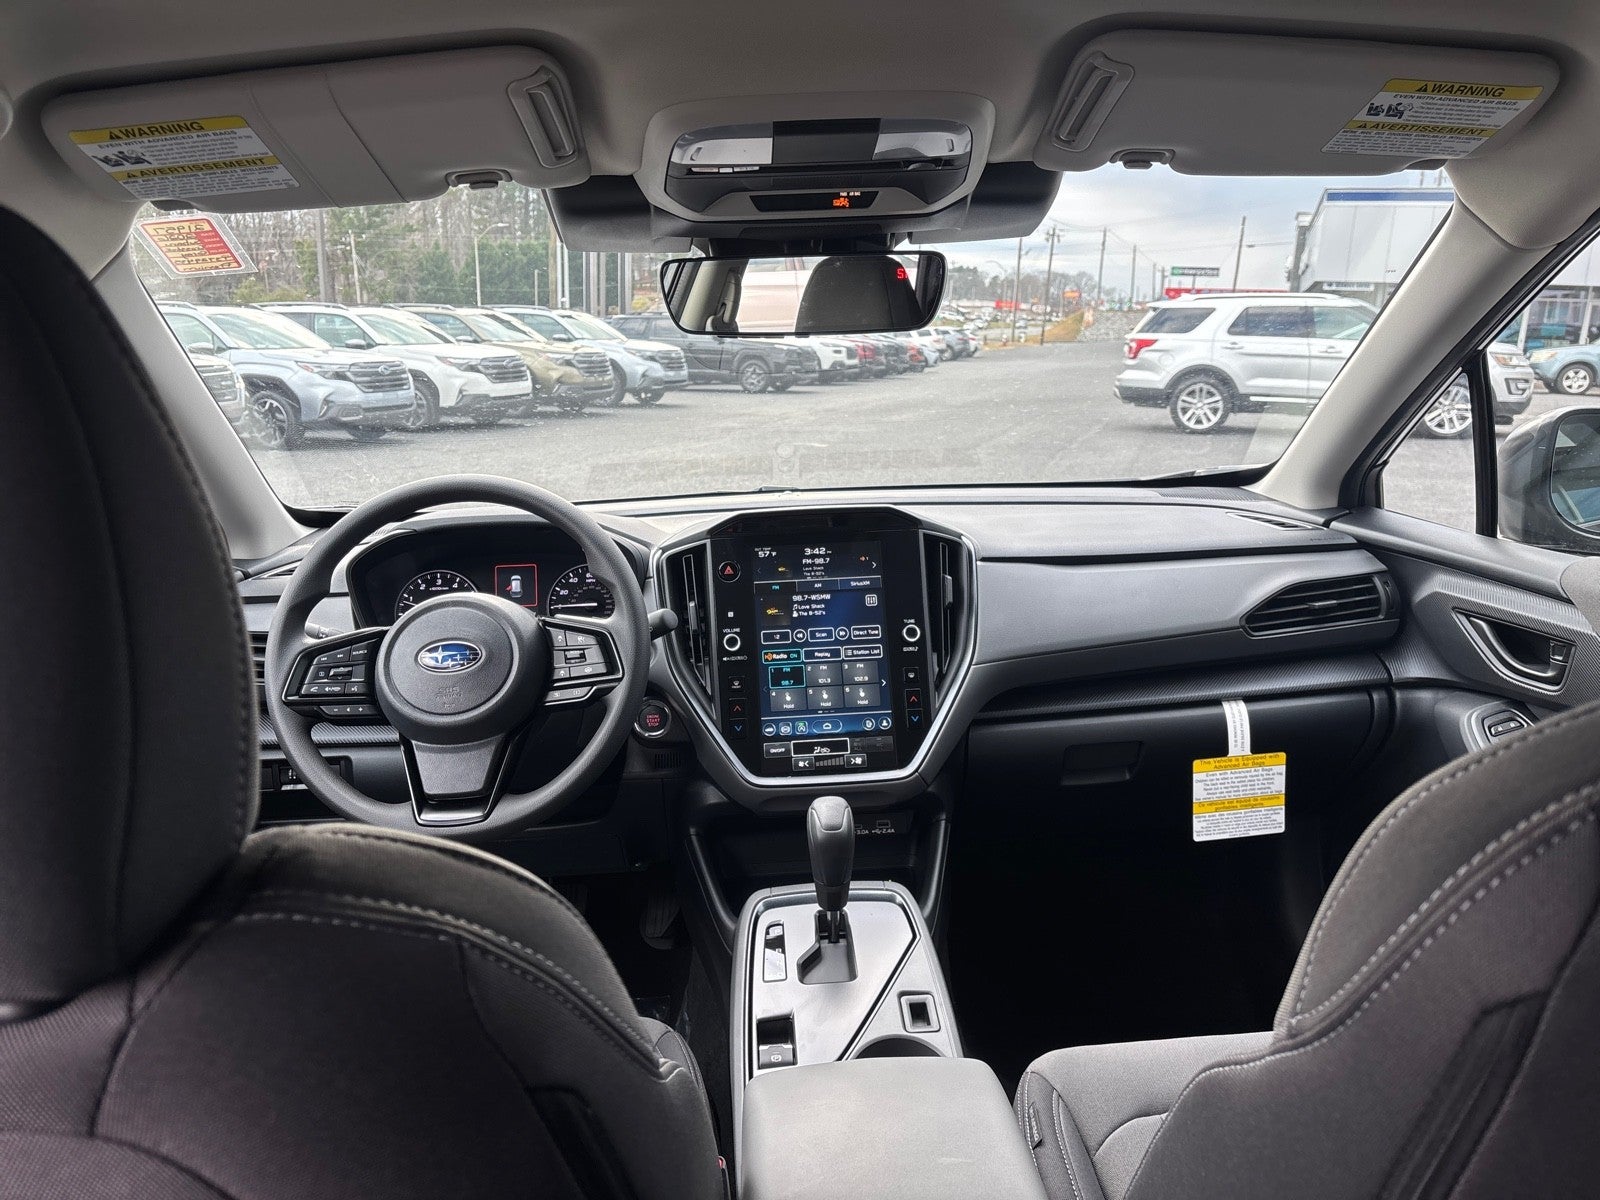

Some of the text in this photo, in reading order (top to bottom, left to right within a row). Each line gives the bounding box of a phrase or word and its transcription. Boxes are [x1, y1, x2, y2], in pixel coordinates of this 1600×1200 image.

[1430, 83, 1506, 97] WARNING
[1436, 96, 1481, 104] ADVANCED
[122, 121, 205, 139] WARNING
[1371, 123, 1487, 136] AVERTISSEMENT
[147, 134, 193, 144] ADVANCED
[140, 158, 266, 178] AVERTISSEMENT
[804, 547, 826, 555] 3:42
[792, 594, 831, 602] 98.7-WSMW
